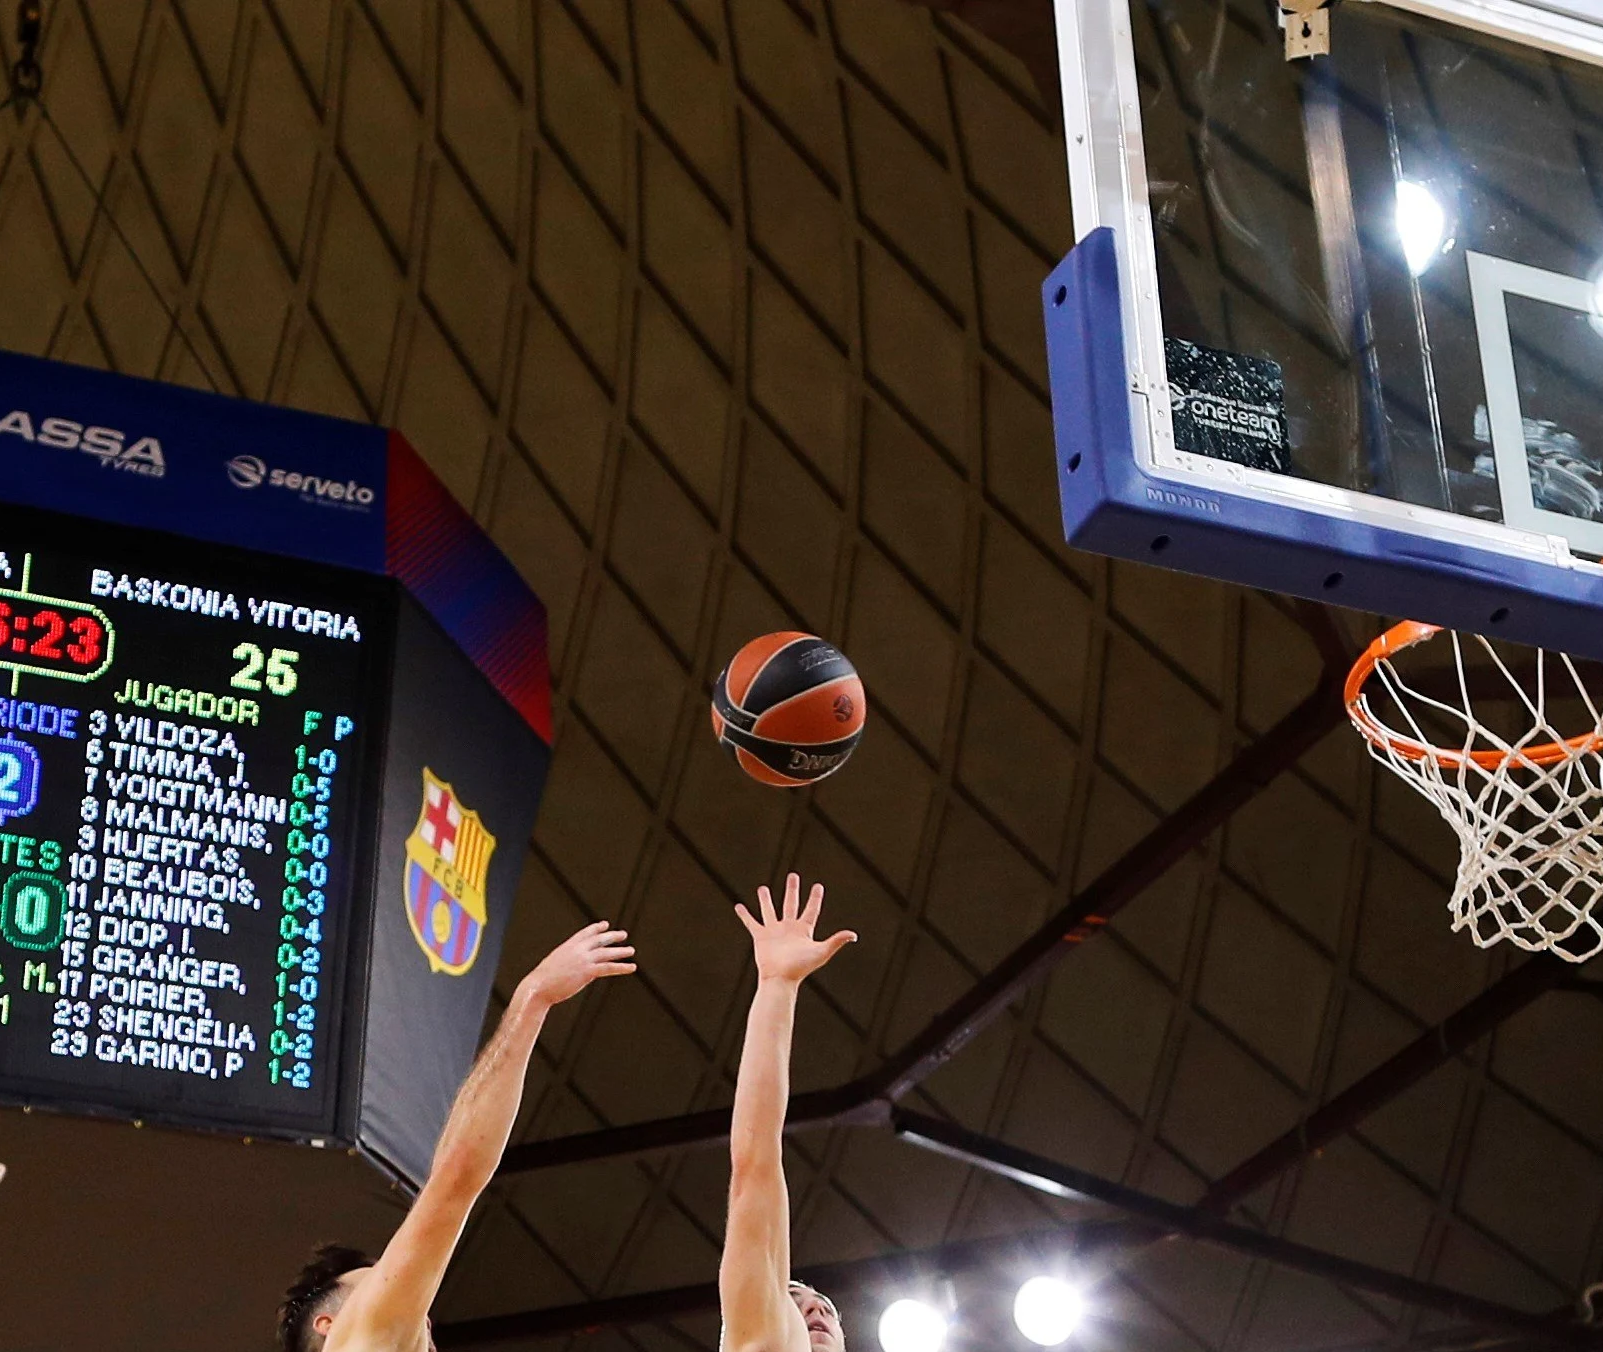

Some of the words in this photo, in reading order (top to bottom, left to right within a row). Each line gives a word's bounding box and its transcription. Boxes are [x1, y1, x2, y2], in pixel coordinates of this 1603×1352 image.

[99, 456, 165, 478] TYRES
[269, 468, 375, 504] serveto
[91, 569, 241, 620] BASKONIA
[248, 596, 361, 642] VITORIA
[230, 642, 299, 696] 25
[114, 679, 260, 726] JUGADOR
[89, 710, 107, 735] 3
[115, 713, 245, 763] VILDOZA,
[85, 738, 104, 764] 6
[109, 741, 221, 786] TIMMA,
[228, 764, 250, 789] J.
[84, 766, 103, 792] 7
[105, 769, 287, 824] VOIGTMANN
[78, 824, 97, 851] 9
[103, 827, 245, 877] HUERTAS,
[80, 796, 99, 821] 8
[104, 799, 273, 854] MALMANIS,
[68, 852, 97, 881] 10
[103, 858, 261, 910] BEAUBOIS,
[14, 886, 50, 935] 0
[63, 909, 91, 939] 12
[99, 915, 175, 954] DIOP,
[182, 928, 195, 954] I.
[66, 881, 88, 909] 11
[95, 886, 231, 934] JANNING,
[23, 960, 56, 993] M.
[60, 939, 86, 968] 15
[93, 944, 246, 995] GRANGER,
[90, 972, 213, 1018] POIRIER,
[53, 998, 91, 1027] 23
[98, 1003, 256, 1050] SHENGELIA
[51, 1028, 89, 1057] 29
[95, 1033, 218, 1079] GARINO,
[224, 1051, 245, 1077] P
